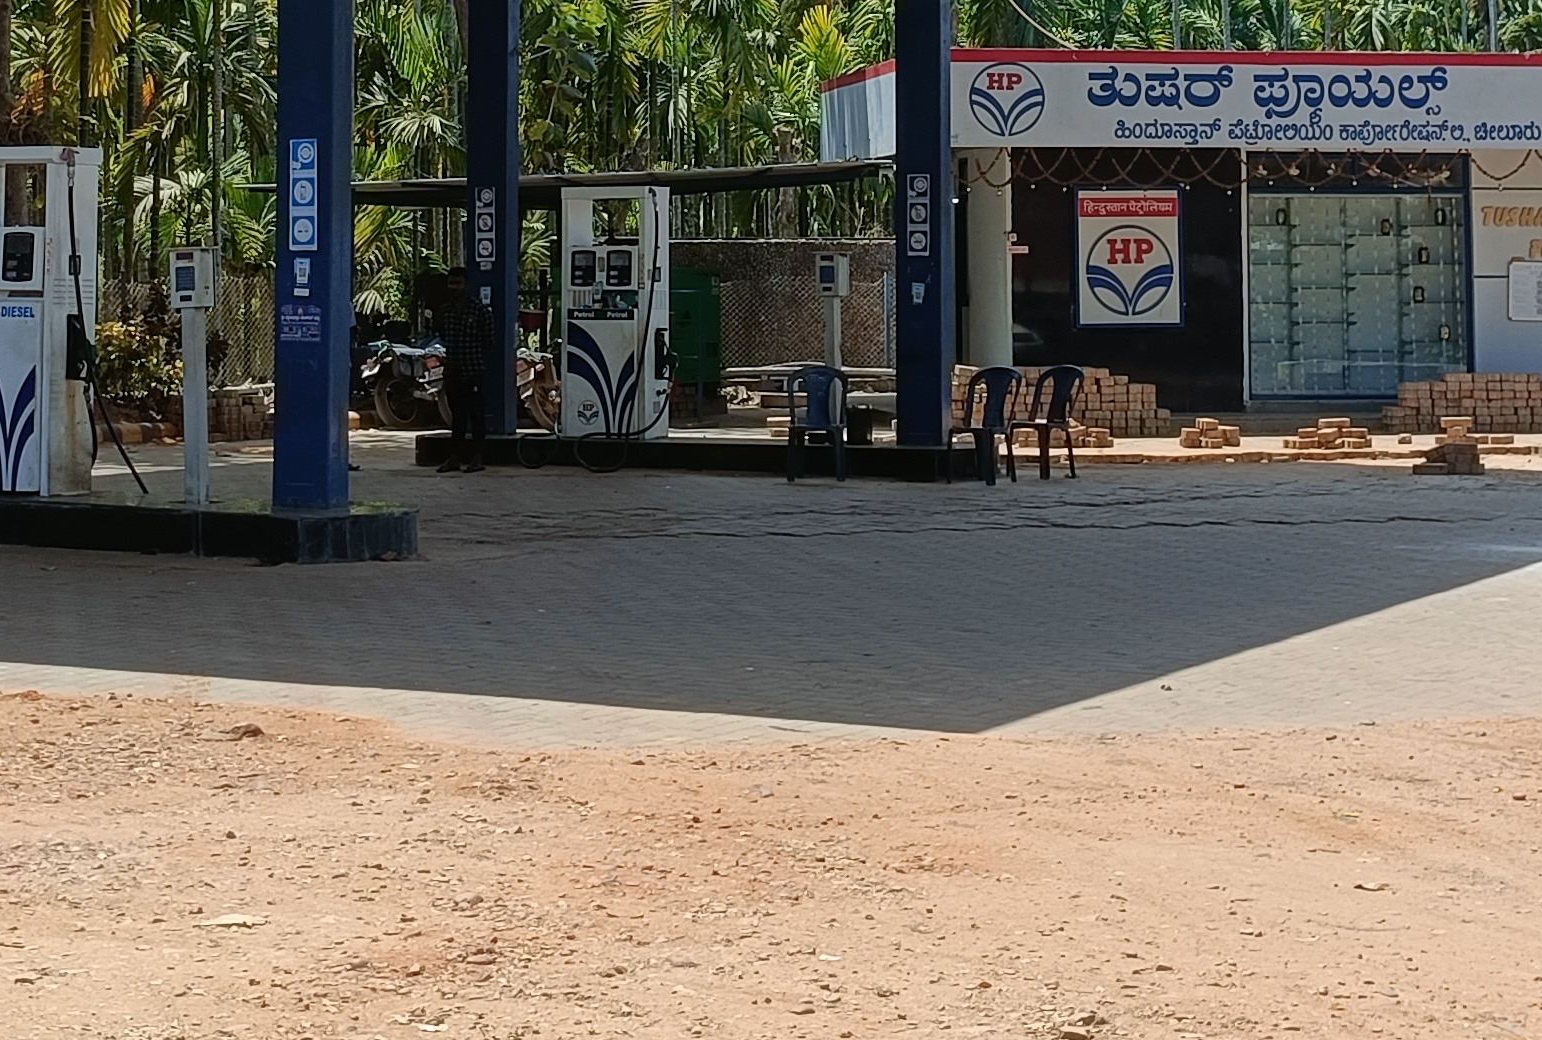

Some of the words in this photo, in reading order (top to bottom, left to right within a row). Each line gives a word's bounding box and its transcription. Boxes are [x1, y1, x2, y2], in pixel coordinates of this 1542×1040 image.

[986, 72, 1023, 91] HP
[1107, 239, 1154, 265] HP
[1, 306, 36, 318] DIESEL
